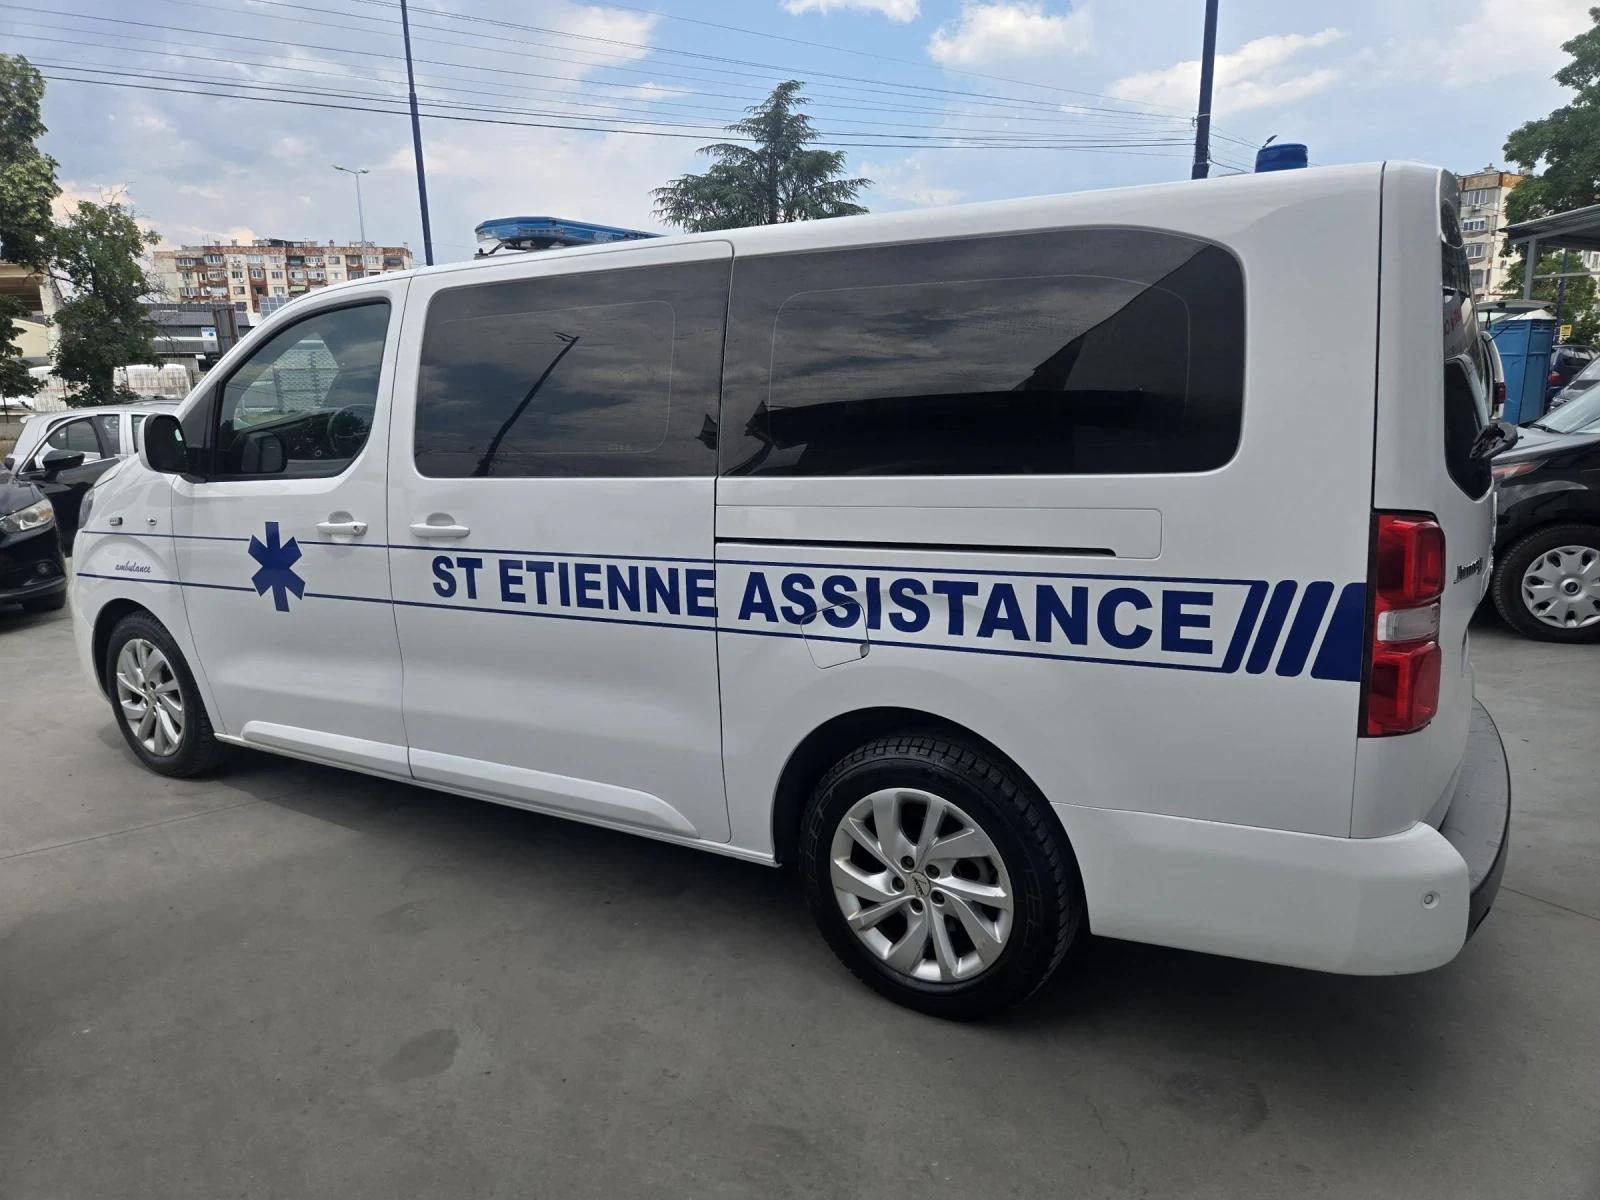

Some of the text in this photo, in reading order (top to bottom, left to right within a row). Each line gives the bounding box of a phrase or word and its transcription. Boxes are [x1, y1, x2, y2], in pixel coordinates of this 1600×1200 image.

[115, 560, 152, 574] ambulance
[432, 556, 1214, 655] ST ETIENNE ASSISTANCE
